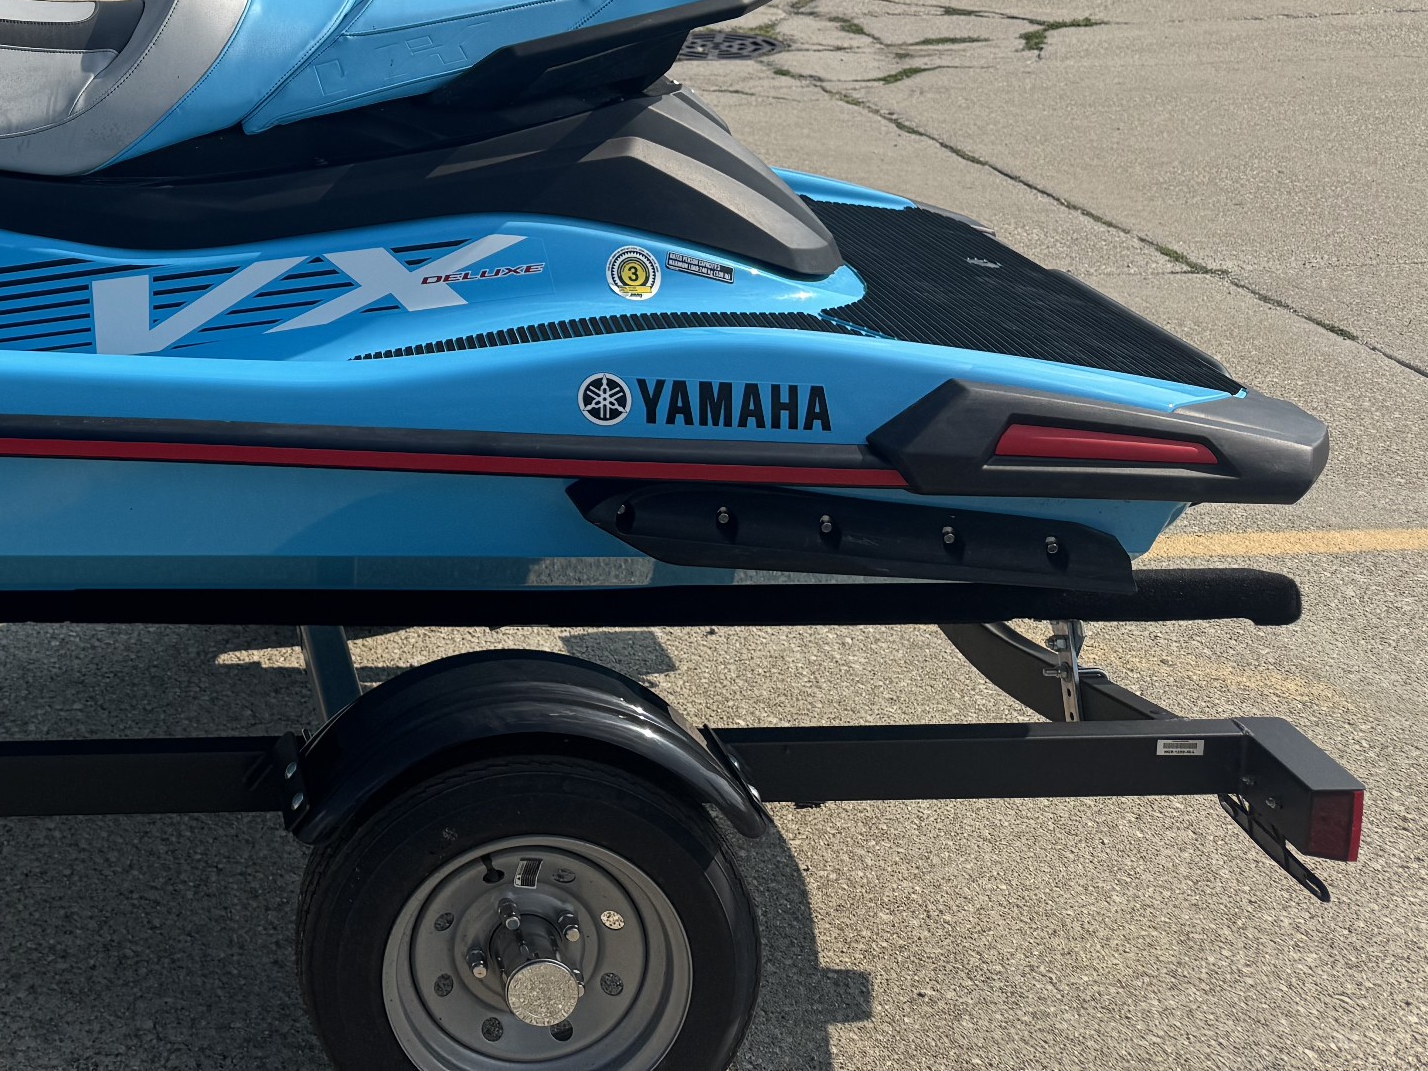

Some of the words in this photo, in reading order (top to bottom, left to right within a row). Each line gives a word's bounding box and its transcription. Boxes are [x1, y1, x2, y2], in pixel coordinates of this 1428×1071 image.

[420, 263, 545, 286] DELUXE
[627, 266, 639, 282] 3
[92, 233, 528, 356] VX
[636, 378, 832, 433] YAMAHA
